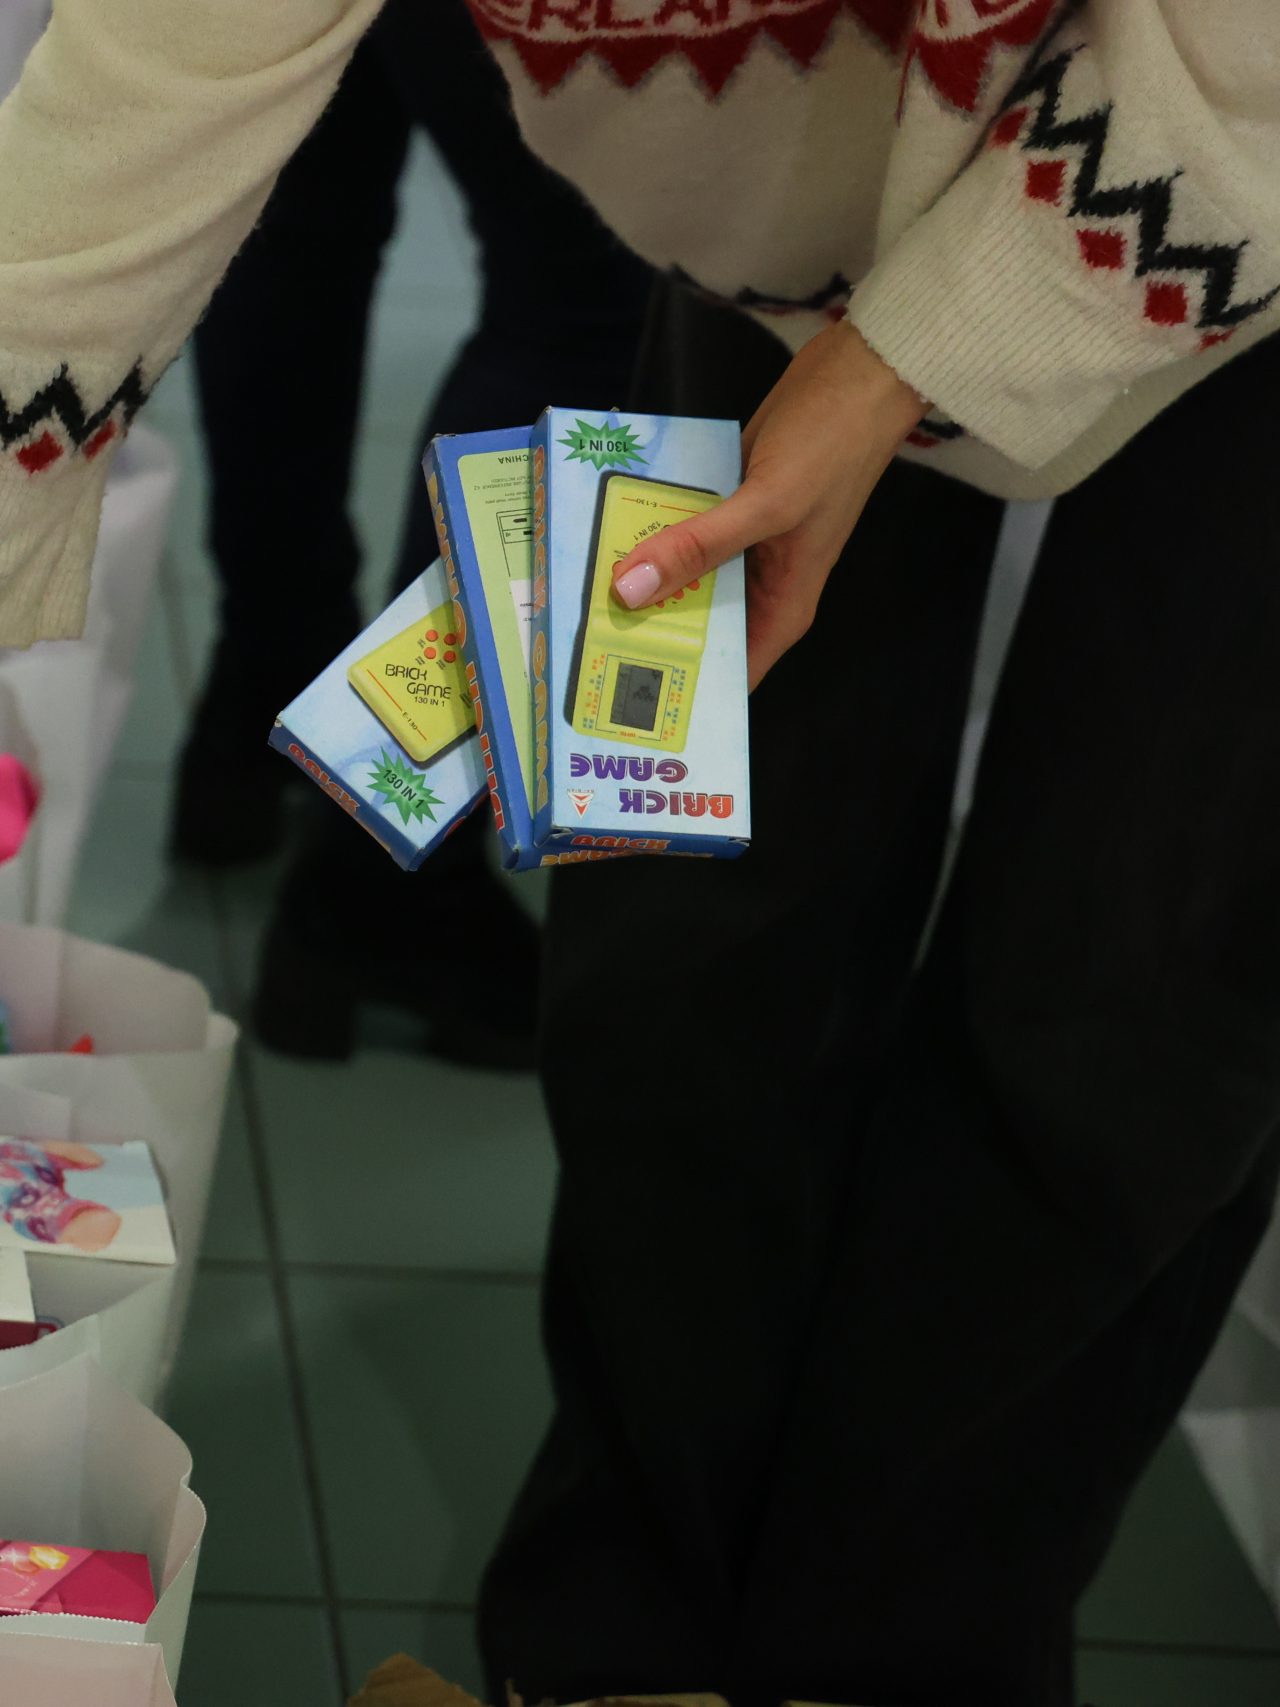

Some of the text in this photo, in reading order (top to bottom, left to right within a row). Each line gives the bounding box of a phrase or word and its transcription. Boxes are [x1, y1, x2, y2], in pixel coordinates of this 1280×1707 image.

[579, 439, 629, 453] 130 IN 1
[498, 455, 530, 465] CHINA
[638, 527, 649, 538] IN
[648, 520, 661, 532] 130
[385, 663, 427, 681] BRICK
[406, 682, 452, 700] GAME
[414, 696, 429, 705] 130
[430, 698, 439, 706] IN
[570, 753, 688, 784] GAME
[383, 769, 425, 809] 130 IN 1
[619, 789, 734, 819] BRICK
[571, 835, 671, 850] BRICK
